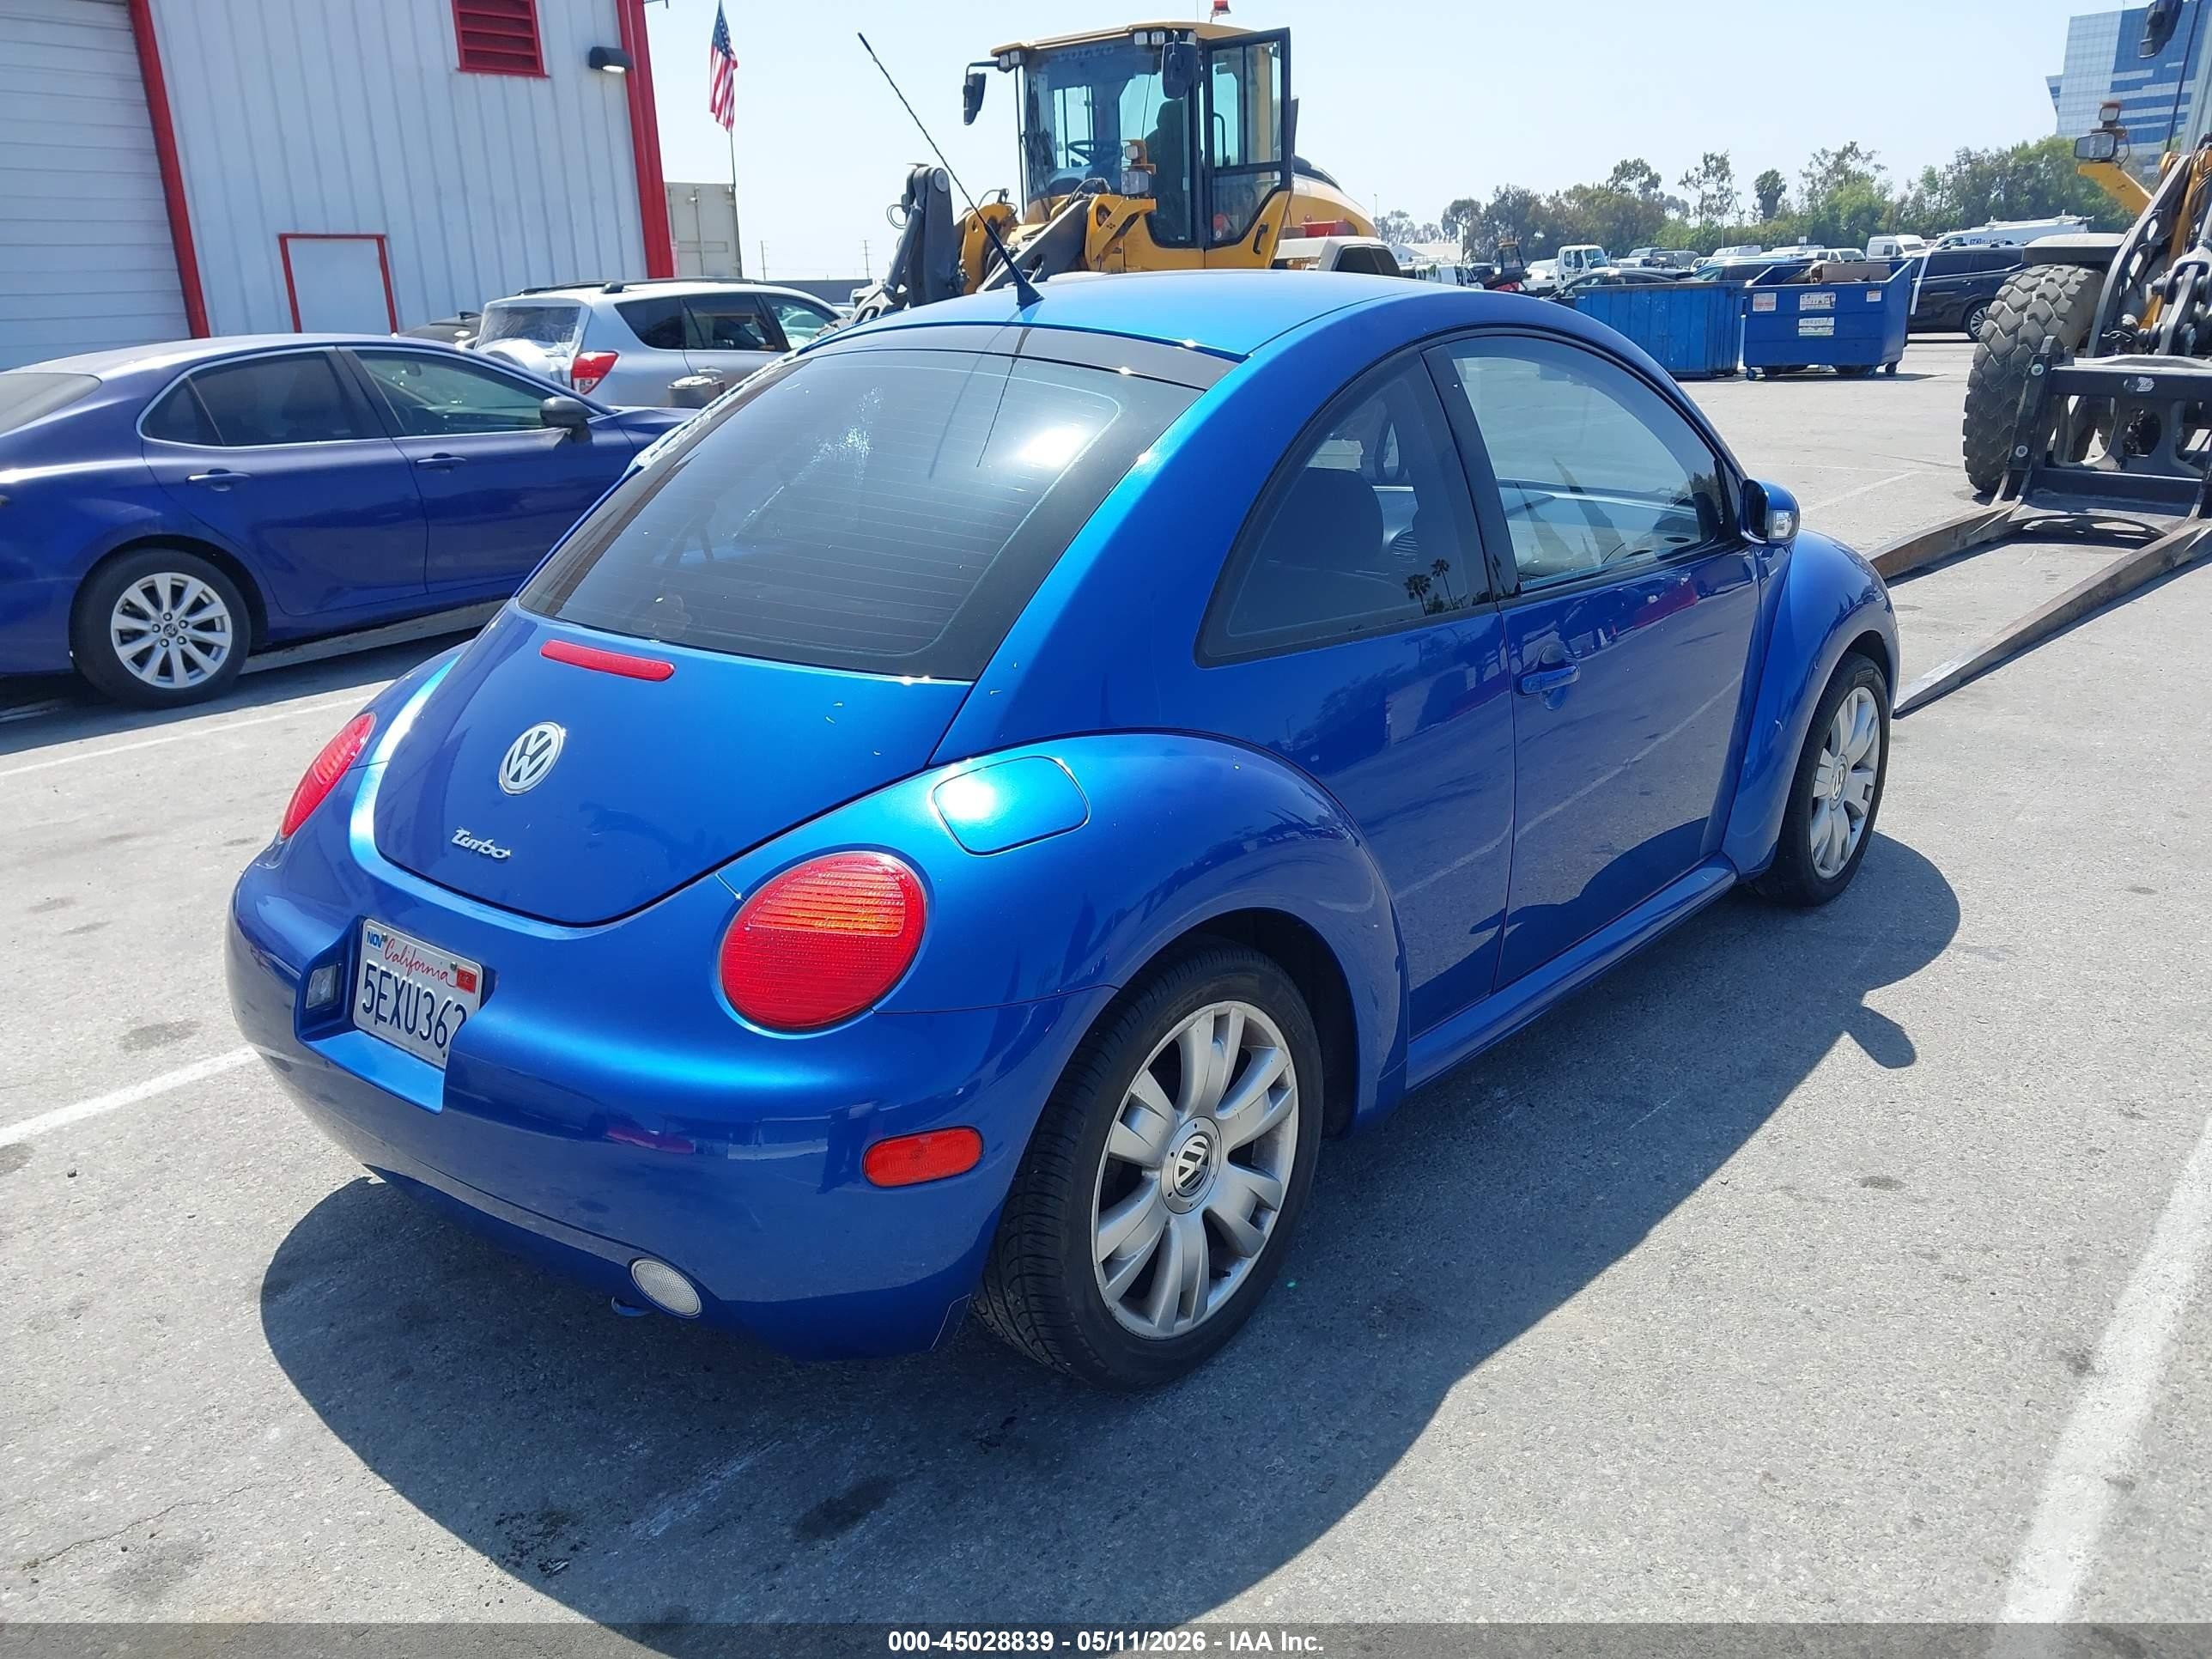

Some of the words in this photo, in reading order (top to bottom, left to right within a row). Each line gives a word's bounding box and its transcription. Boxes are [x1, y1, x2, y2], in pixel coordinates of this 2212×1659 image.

[452, 826, 511, 858] Turbo
[367, 932, 382, 949] NOV
[384, 939, 456, 988] California
